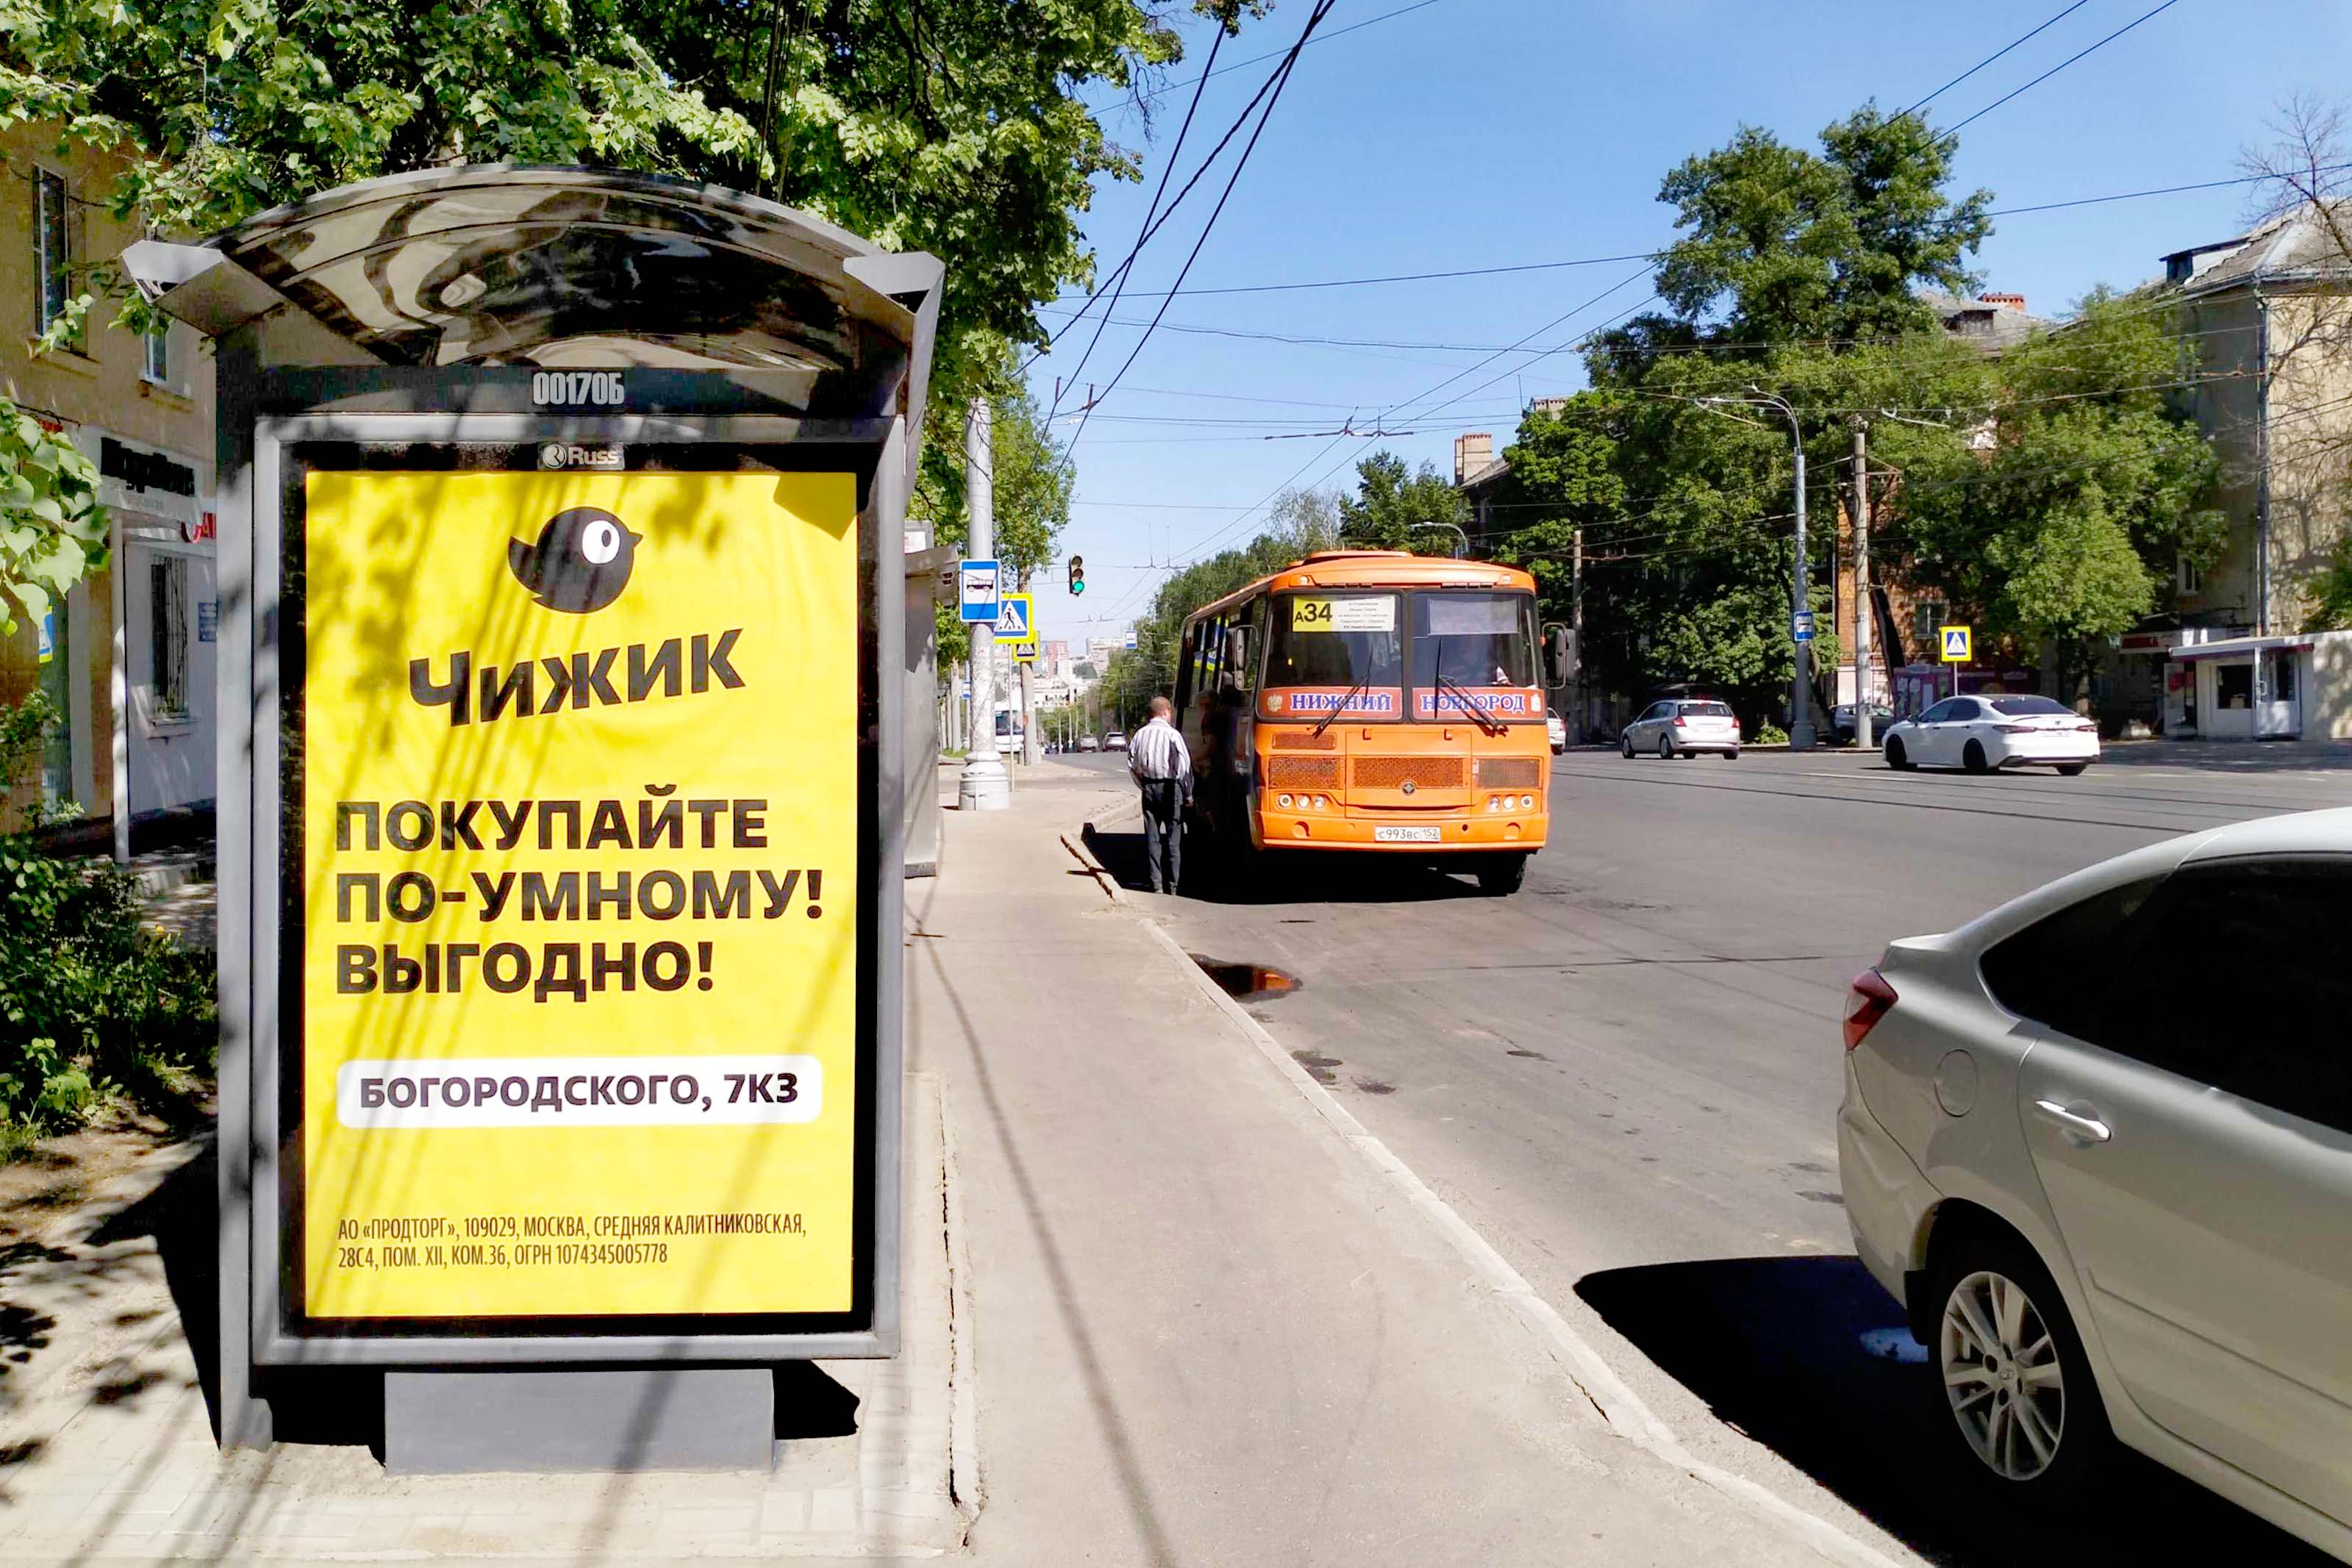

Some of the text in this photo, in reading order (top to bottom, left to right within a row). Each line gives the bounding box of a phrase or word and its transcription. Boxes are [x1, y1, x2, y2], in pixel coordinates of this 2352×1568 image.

[1291, 693, 1393, 712] НИЖНИЙ
[336, 784, 768, 851] ПОКУПАЙТЕ
[336, 869, 822, 923] ПО-УМНОМУ!
[336, 941, 714, 1003] ВЫГОДНО!
[360, 1073, 712, 1112] БОГОРОДСКОГО,
[337, 1213, 807, 1242] АО «ПРОДТОРГ», 109029, МОСКВА, СРЕДНЯЯ КАЛИТНИКОВСКАЯ,
[338, 1247, 379, 1271] 28С4,
[383, 1246, 421, 1267] ПОМ.
[451, 1245, 510, 1270] КОМ.36,
[515, 1244, 552, 1265] ОГРН
[556, 1242, 668, 1265] 1074345005778
